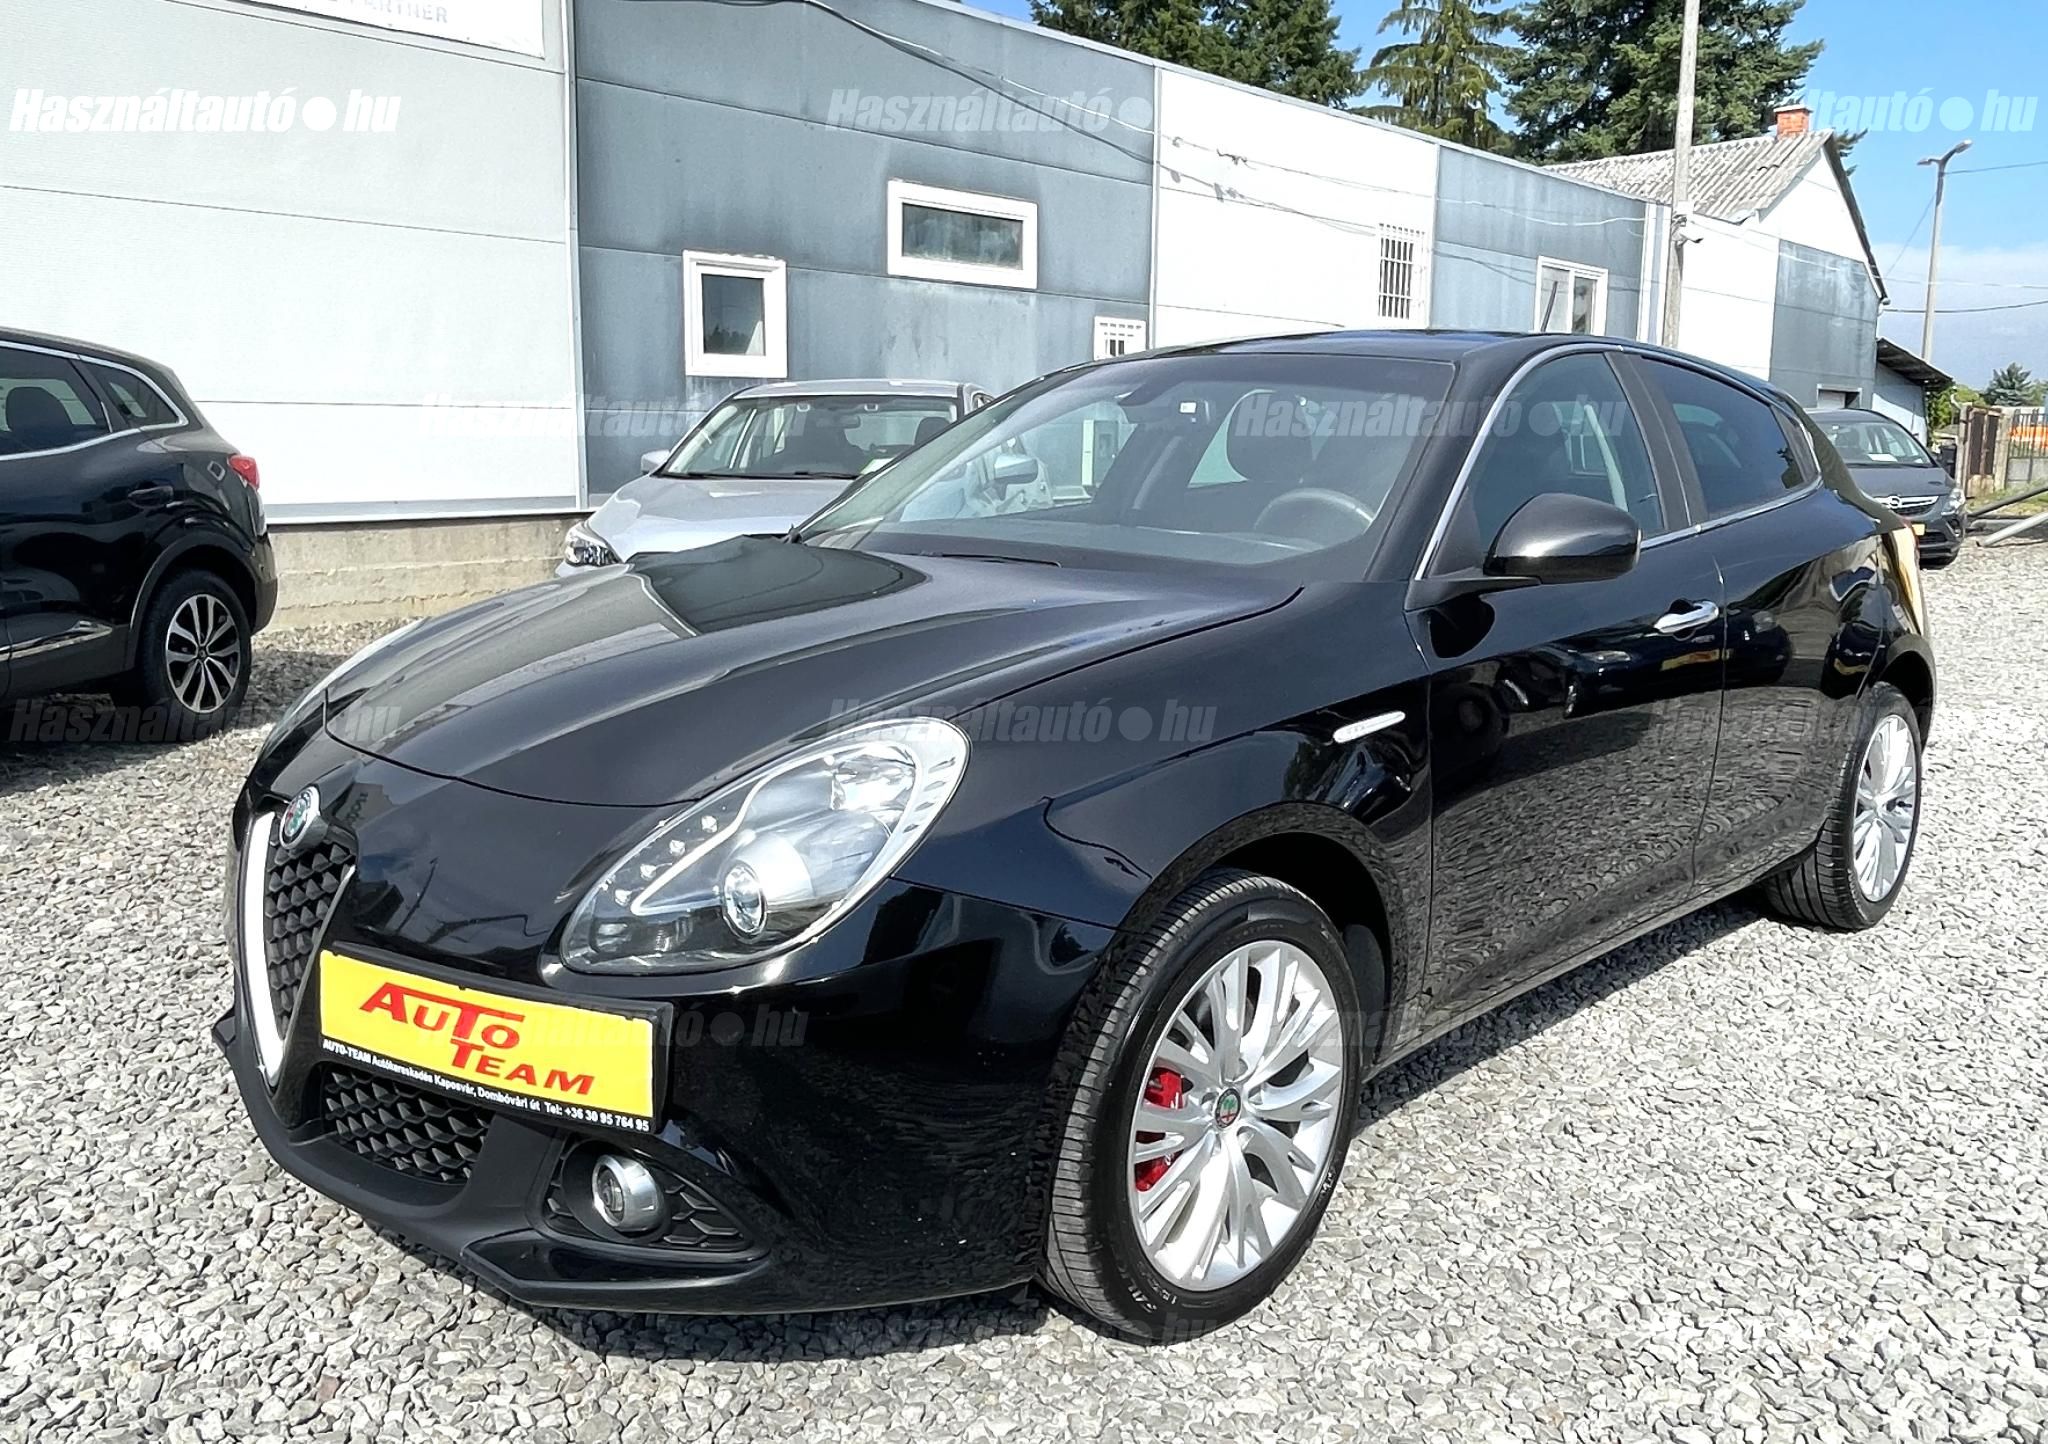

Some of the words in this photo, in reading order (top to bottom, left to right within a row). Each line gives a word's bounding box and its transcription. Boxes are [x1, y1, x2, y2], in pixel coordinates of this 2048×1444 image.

[323, 1039, 372, 1063] AUTO-TEAM
[434, 1075, 477, 1098] Kaposvár,
[478, 1087, 528, 1109] Dombóvári
[544, 1102, 563, 1115] Tel:
[564, 1107, 584, 1120] +36
[585, 1110, 599, 1122] 30
[600, 1112, 614, 1125] 95
[614, 1115, 634, 1129] 764
[635, 1118, 650, 1132] 95
[450, 1038, 595, 1095] TEAM
